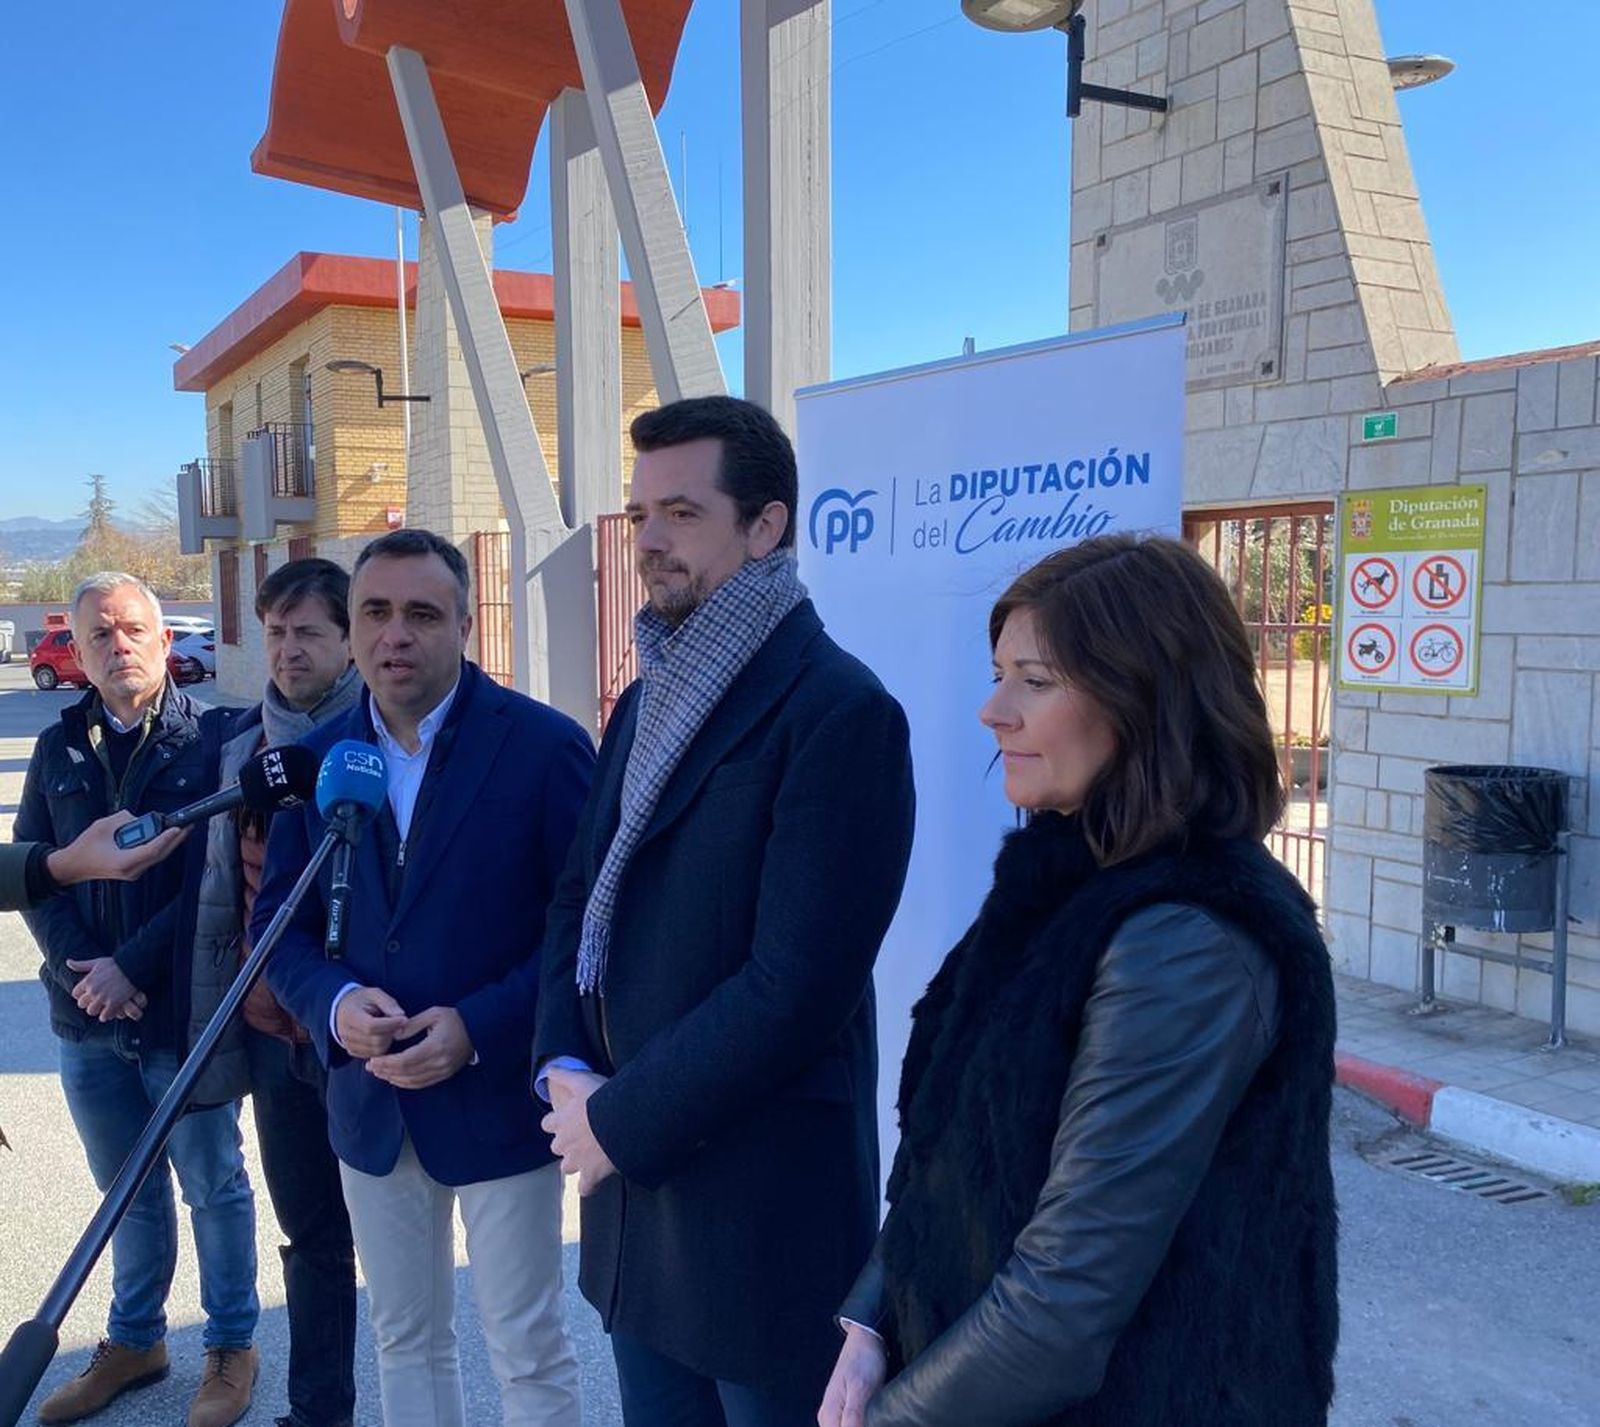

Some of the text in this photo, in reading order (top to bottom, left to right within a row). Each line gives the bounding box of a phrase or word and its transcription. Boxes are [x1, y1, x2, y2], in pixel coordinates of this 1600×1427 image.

[1215, 290, 1266, 316] GRANADA
[914, 447, 1151, 507] La DIPUTACIÓN
[1388, 496, 1479, 517] Diputación
[912, 492, 1119, 555] del Cambio
[1388, 512, 1480, 532] de Granada
